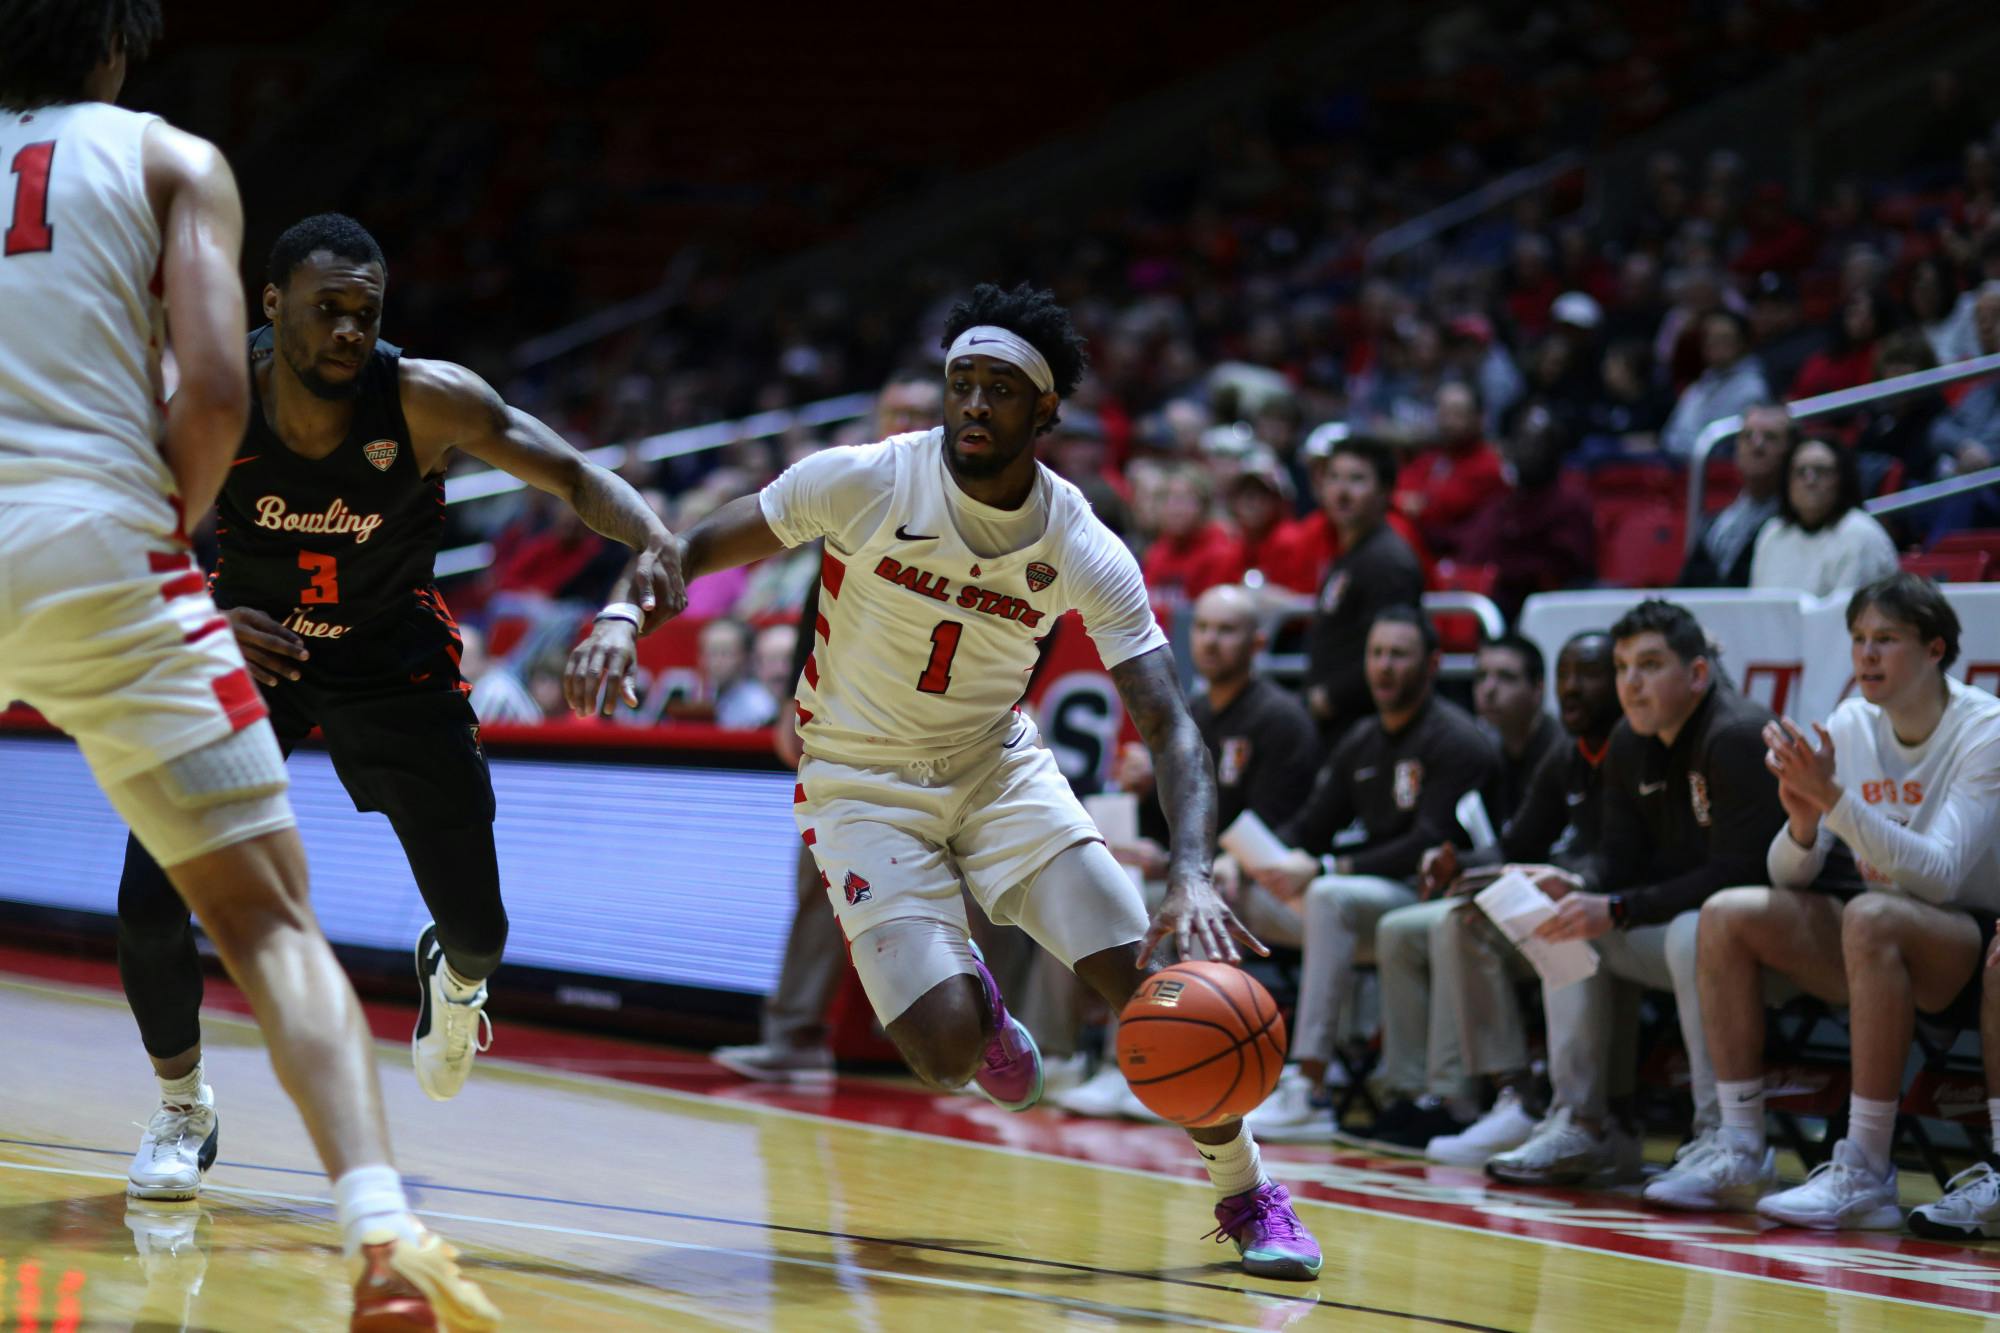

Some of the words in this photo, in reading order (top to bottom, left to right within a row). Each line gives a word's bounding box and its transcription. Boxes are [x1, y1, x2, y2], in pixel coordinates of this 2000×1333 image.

[0, 139, 57, 258] 1
[255, 496, 384, 544] Bowling
[298, 549, 340, 605] 3
[873, 556, 950, 602] BALL
[956, 585, 1047, 629] STATE
[916, 619, 964, 695] 1
